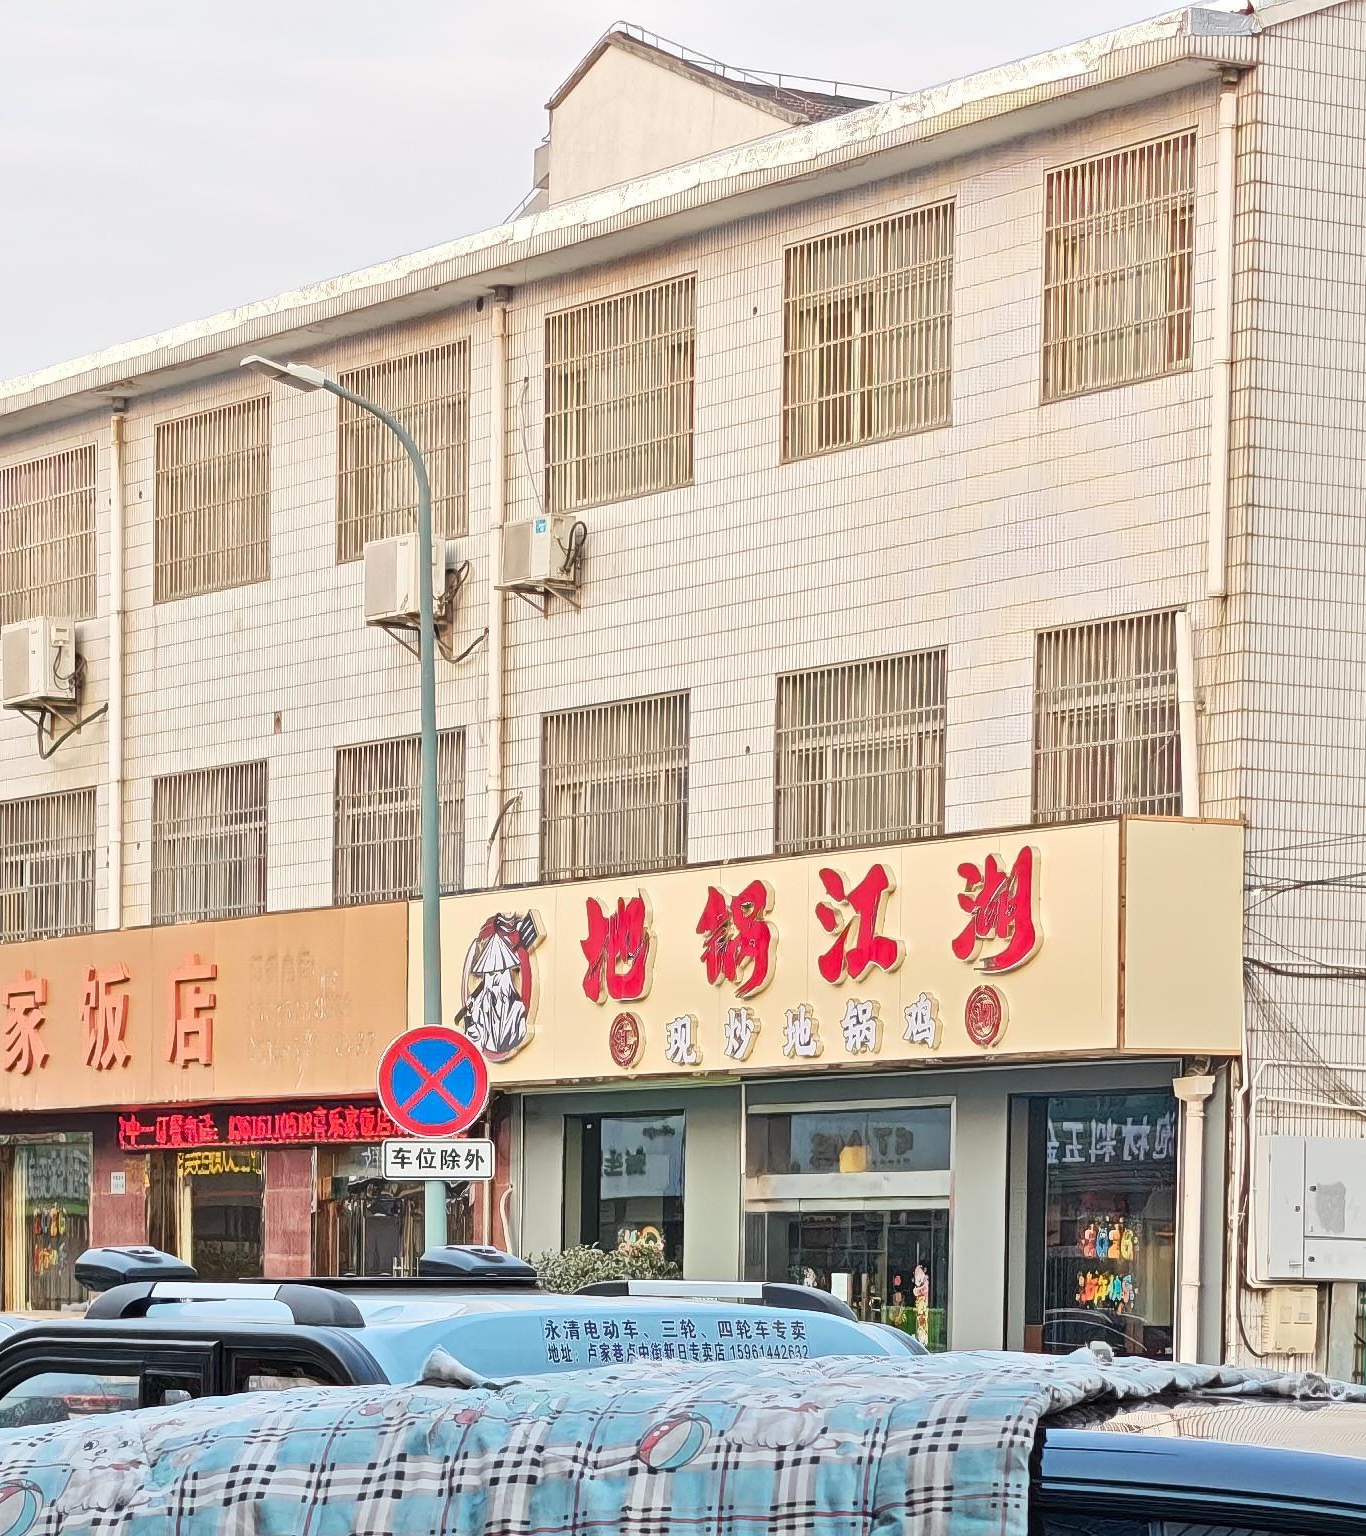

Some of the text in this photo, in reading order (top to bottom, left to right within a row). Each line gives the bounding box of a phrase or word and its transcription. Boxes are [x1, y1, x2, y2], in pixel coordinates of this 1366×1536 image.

[579, 845, 1039, 1002] 地锅江湖
[664, 993, 940, 1066] 现炒地锅鸡
[390, 1147, 485, 1172] 车位除外
[544, 1319, 807, 1341] 永清电动车、三轮、四轮车专卖
